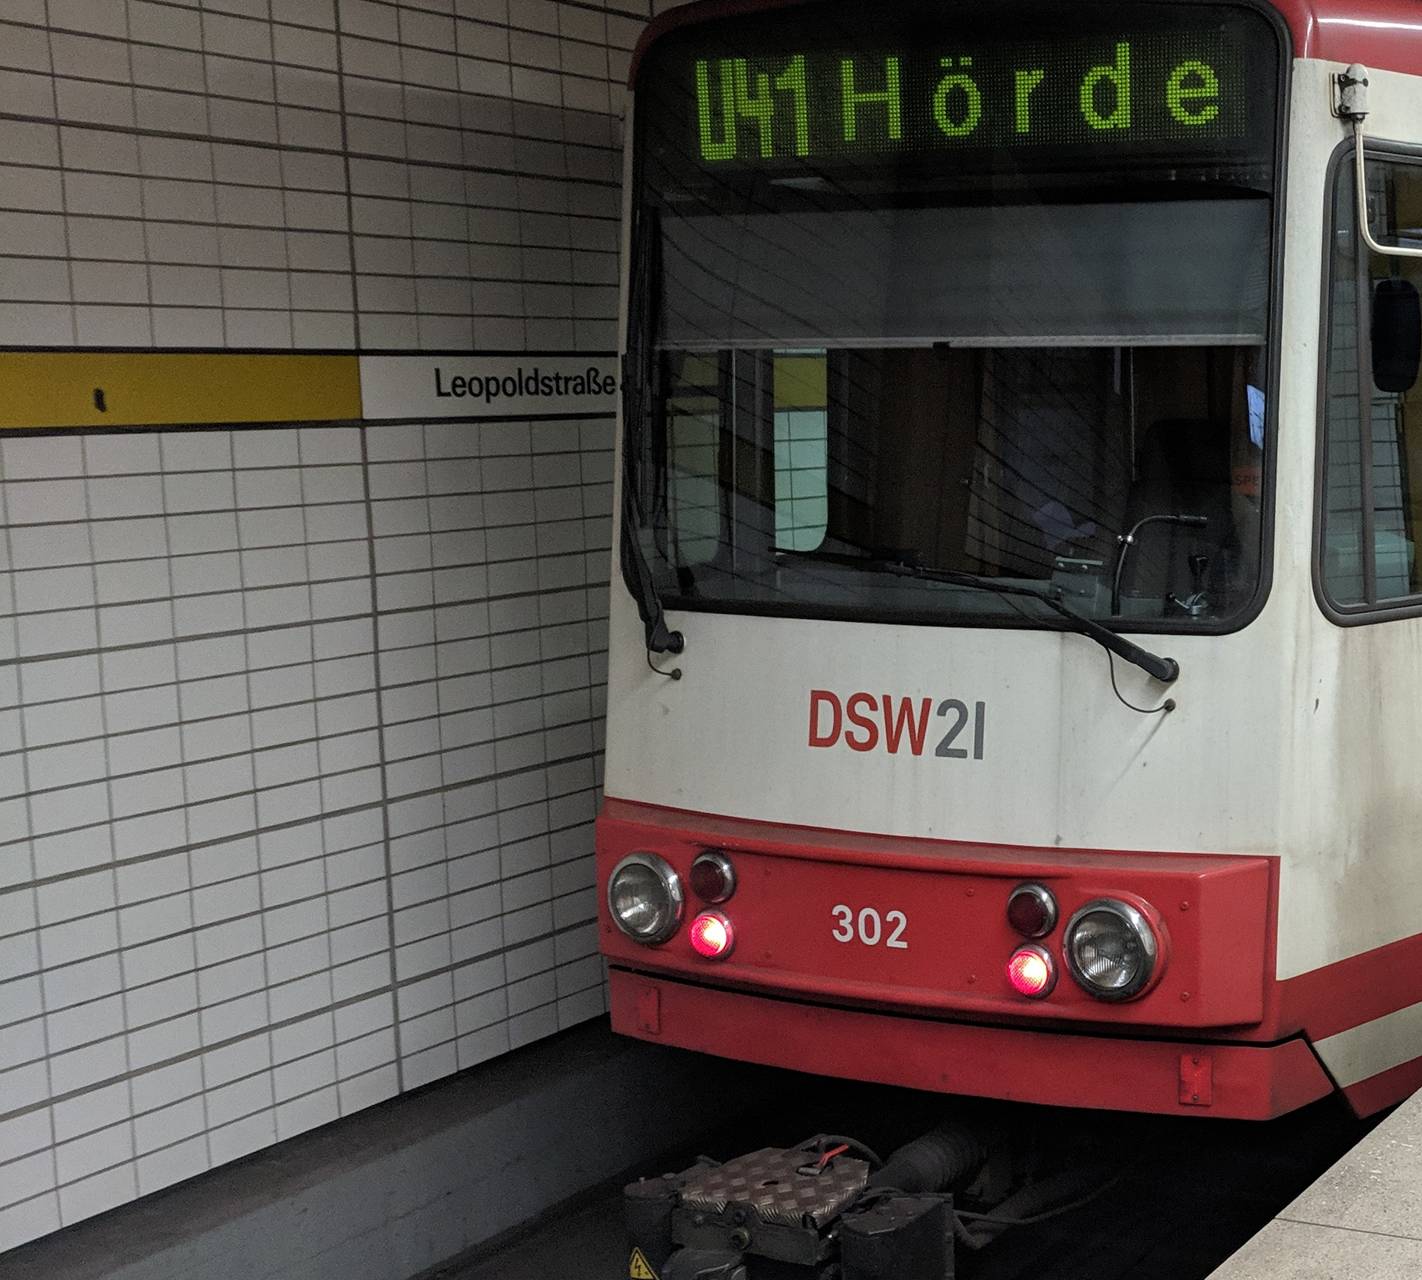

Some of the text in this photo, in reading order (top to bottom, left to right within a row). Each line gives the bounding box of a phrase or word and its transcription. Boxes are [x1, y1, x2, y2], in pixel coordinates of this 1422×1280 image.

[695, 42, 1220, 161] U41 Hörde
[434, 367, 616, 403] Leopoldstraße
[808, 689, 986, 760] DSW21
[831, 904, 908, 949] 302
